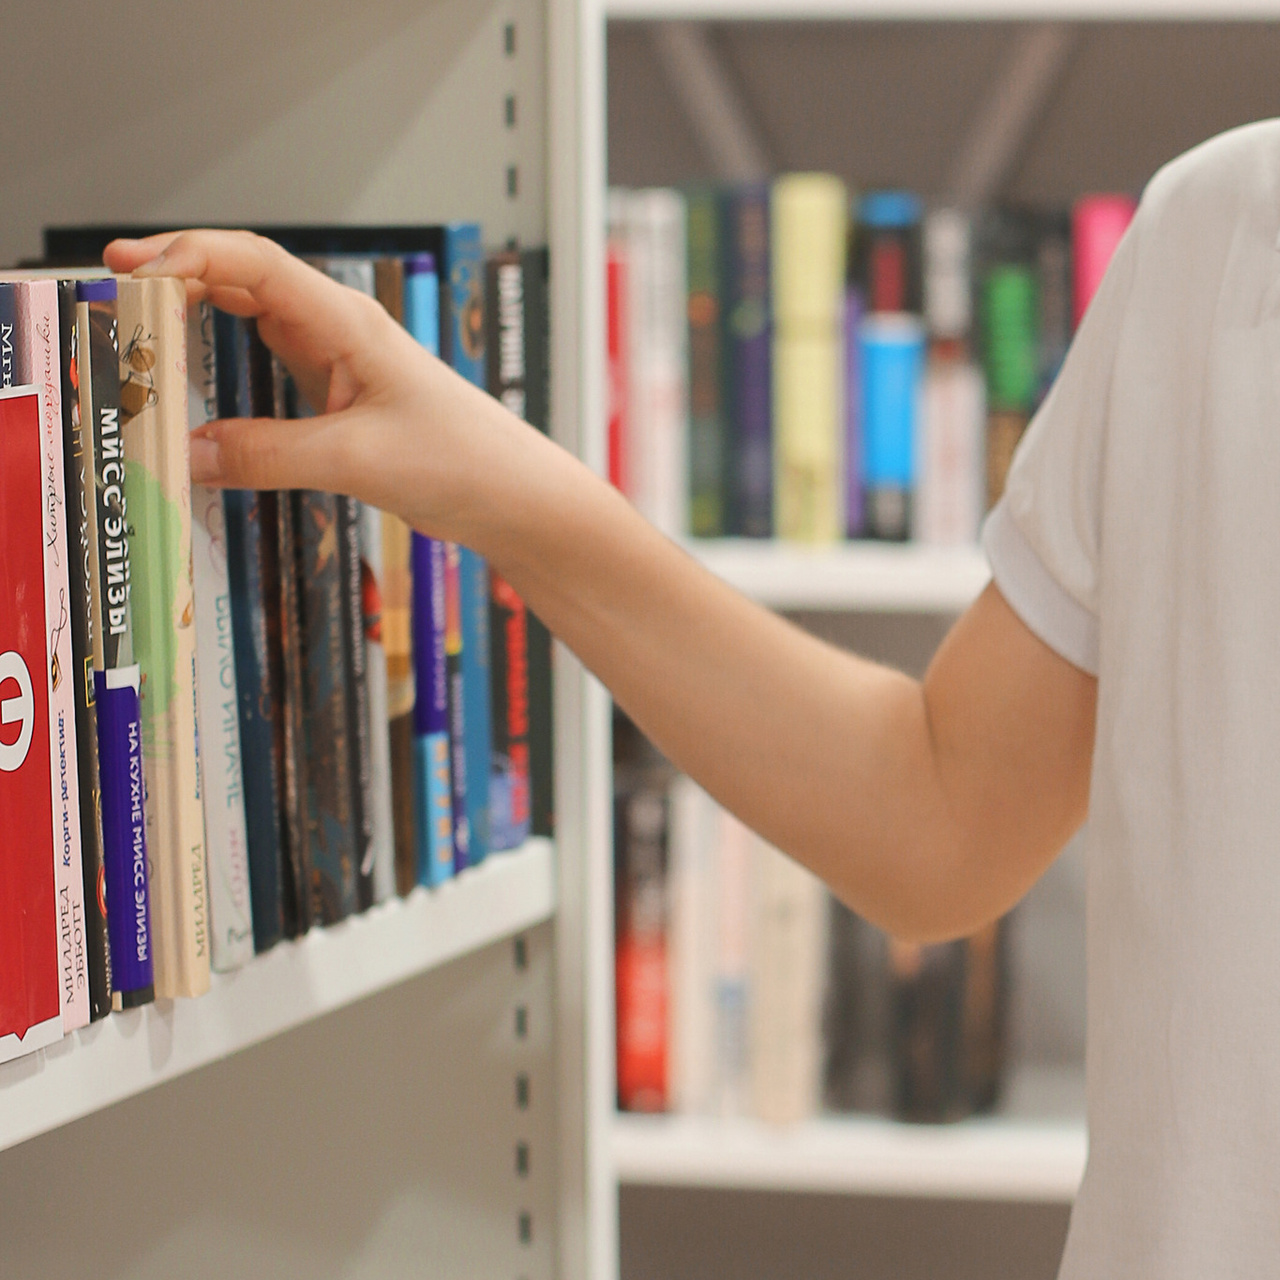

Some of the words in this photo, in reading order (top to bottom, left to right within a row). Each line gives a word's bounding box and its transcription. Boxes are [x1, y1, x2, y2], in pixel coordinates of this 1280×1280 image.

[46, 452, 62, 568] Хитрые
[128, 721, 138, 753] НА
[129, 755, 141, 823] КУХНЕ
[132, 826, 144, 886] МИСС
[61, 885, 76, 1005] МИЛДРЕД
[73, 901, 86, 990] ЭББОТТ
[135, 889, 148, 962] ЭЛИЗЫ
